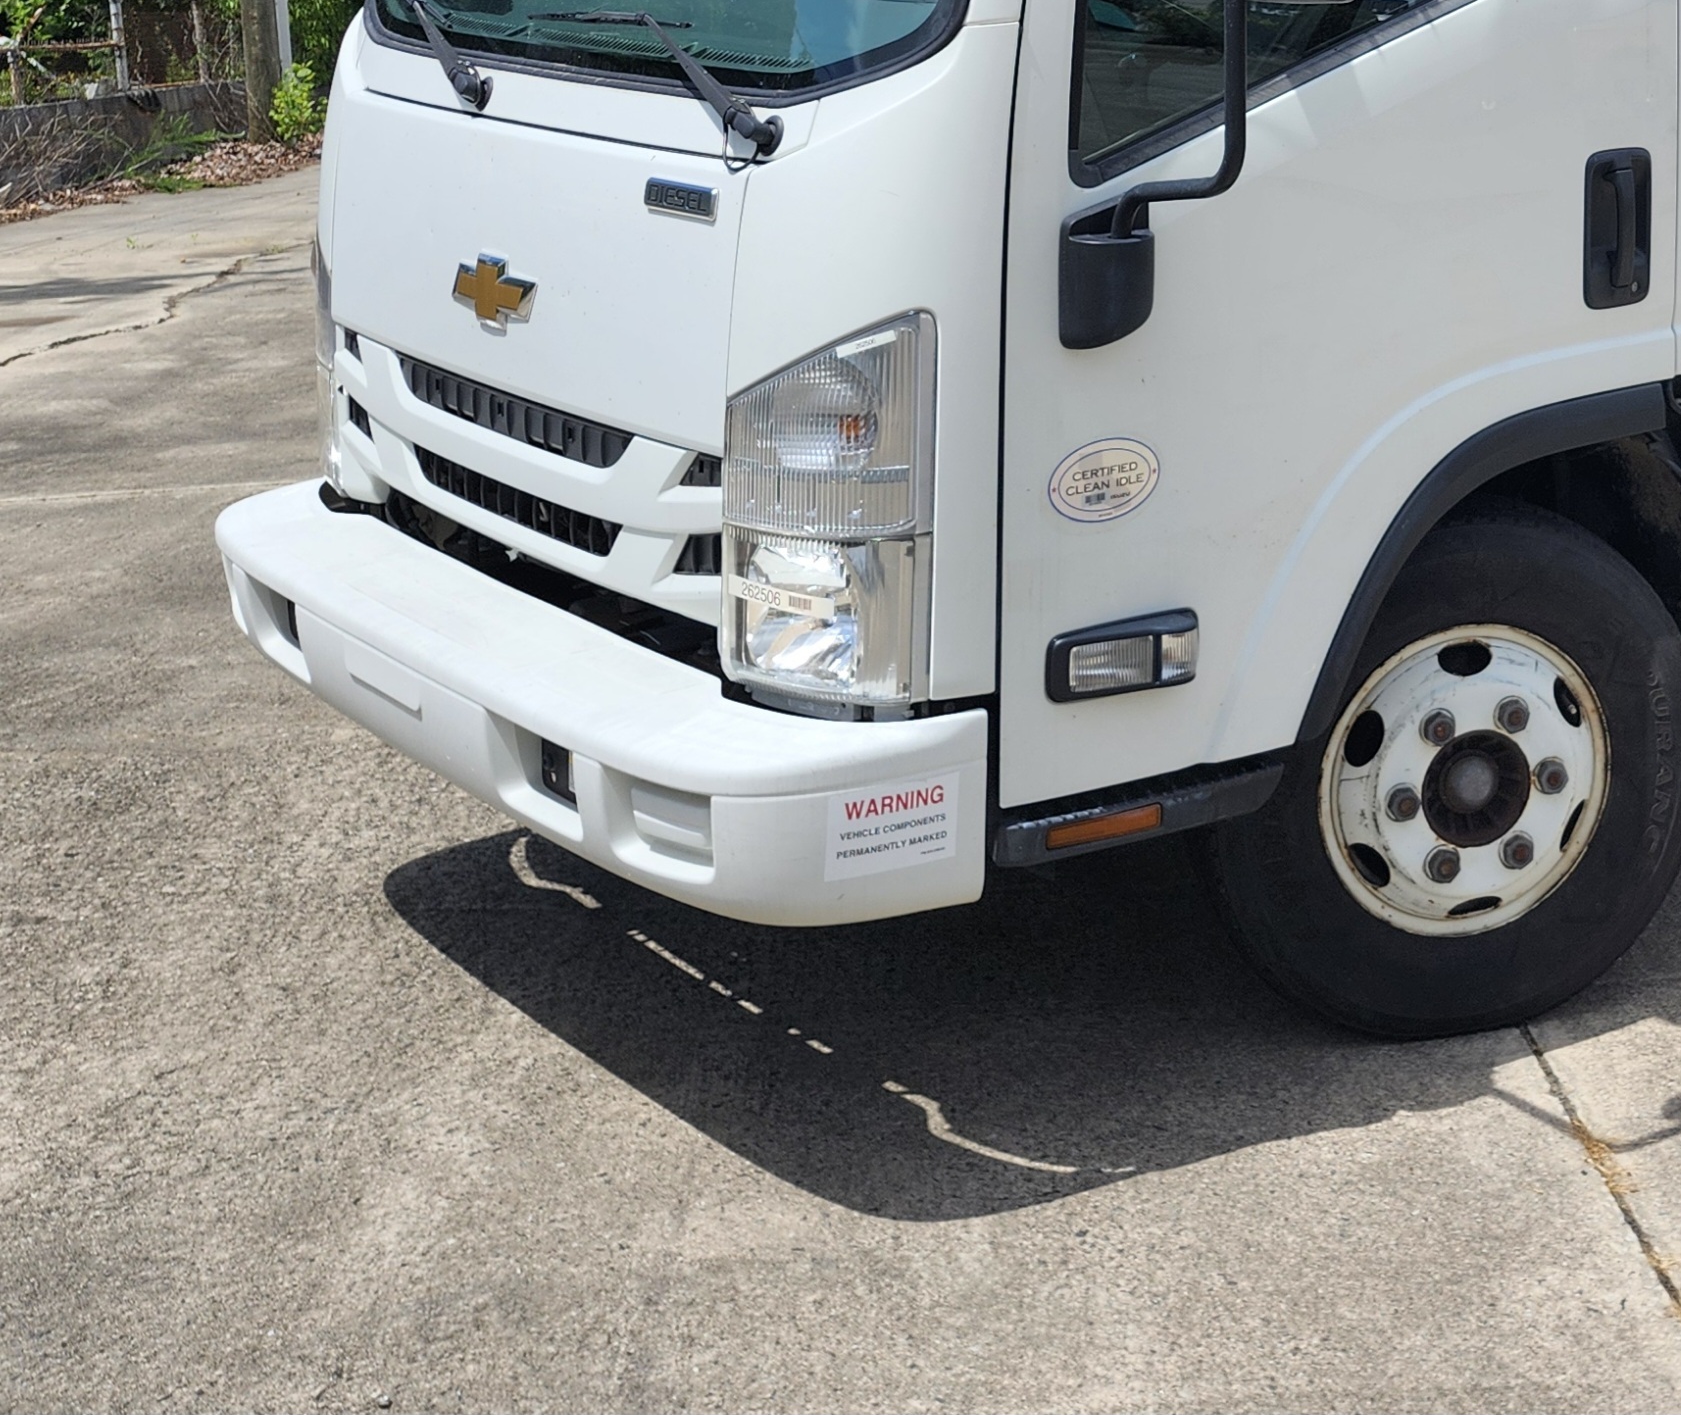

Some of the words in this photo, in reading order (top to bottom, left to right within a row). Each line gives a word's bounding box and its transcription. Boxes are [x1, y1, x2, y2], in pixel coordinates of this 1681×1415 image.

[647, 183, 707, 212] DIESEL
[1065, 479, 1111, 496] CLEAN
[1116, 472, 1145, 487] IDLE
[1072, 461, 1138, 482] CERTIFIED
[741, 581, 781, 606] 262506
[844, 785, 945, 821] WARNING
[839, 827, 880, 841] VEHICLE
[883, 813, 946, 834] COMPONENTS
[836, 840, 907, 860] PERMANENTLY
[909, 830, 948, 846] MARKED
